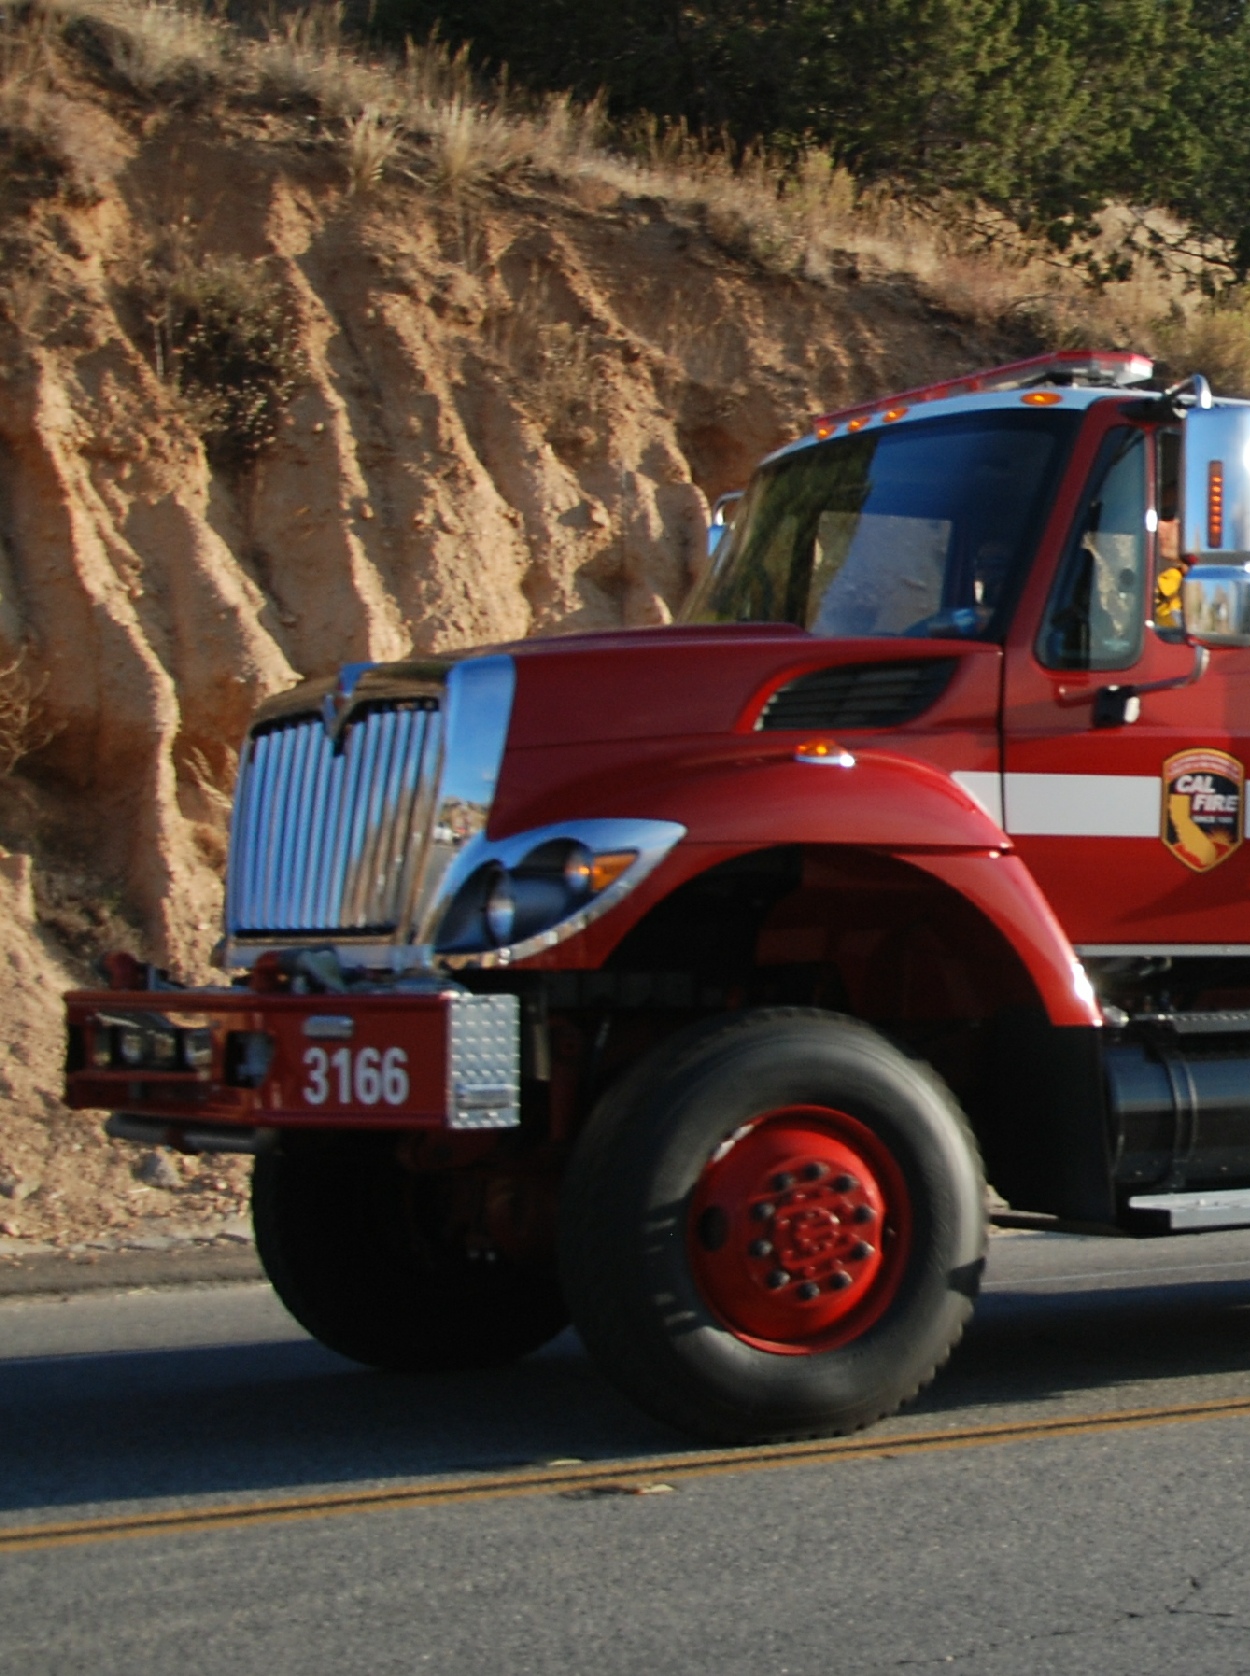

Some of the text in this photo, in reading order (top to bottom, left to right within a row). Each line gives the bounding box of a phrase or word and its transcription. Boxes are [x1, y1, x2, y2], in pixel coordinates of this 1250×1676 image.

[1175, 774, 1216, 793] CAL
[1192, 794, 1240, 812] FIRE
[303, 1046, 410, 1105] 3166
